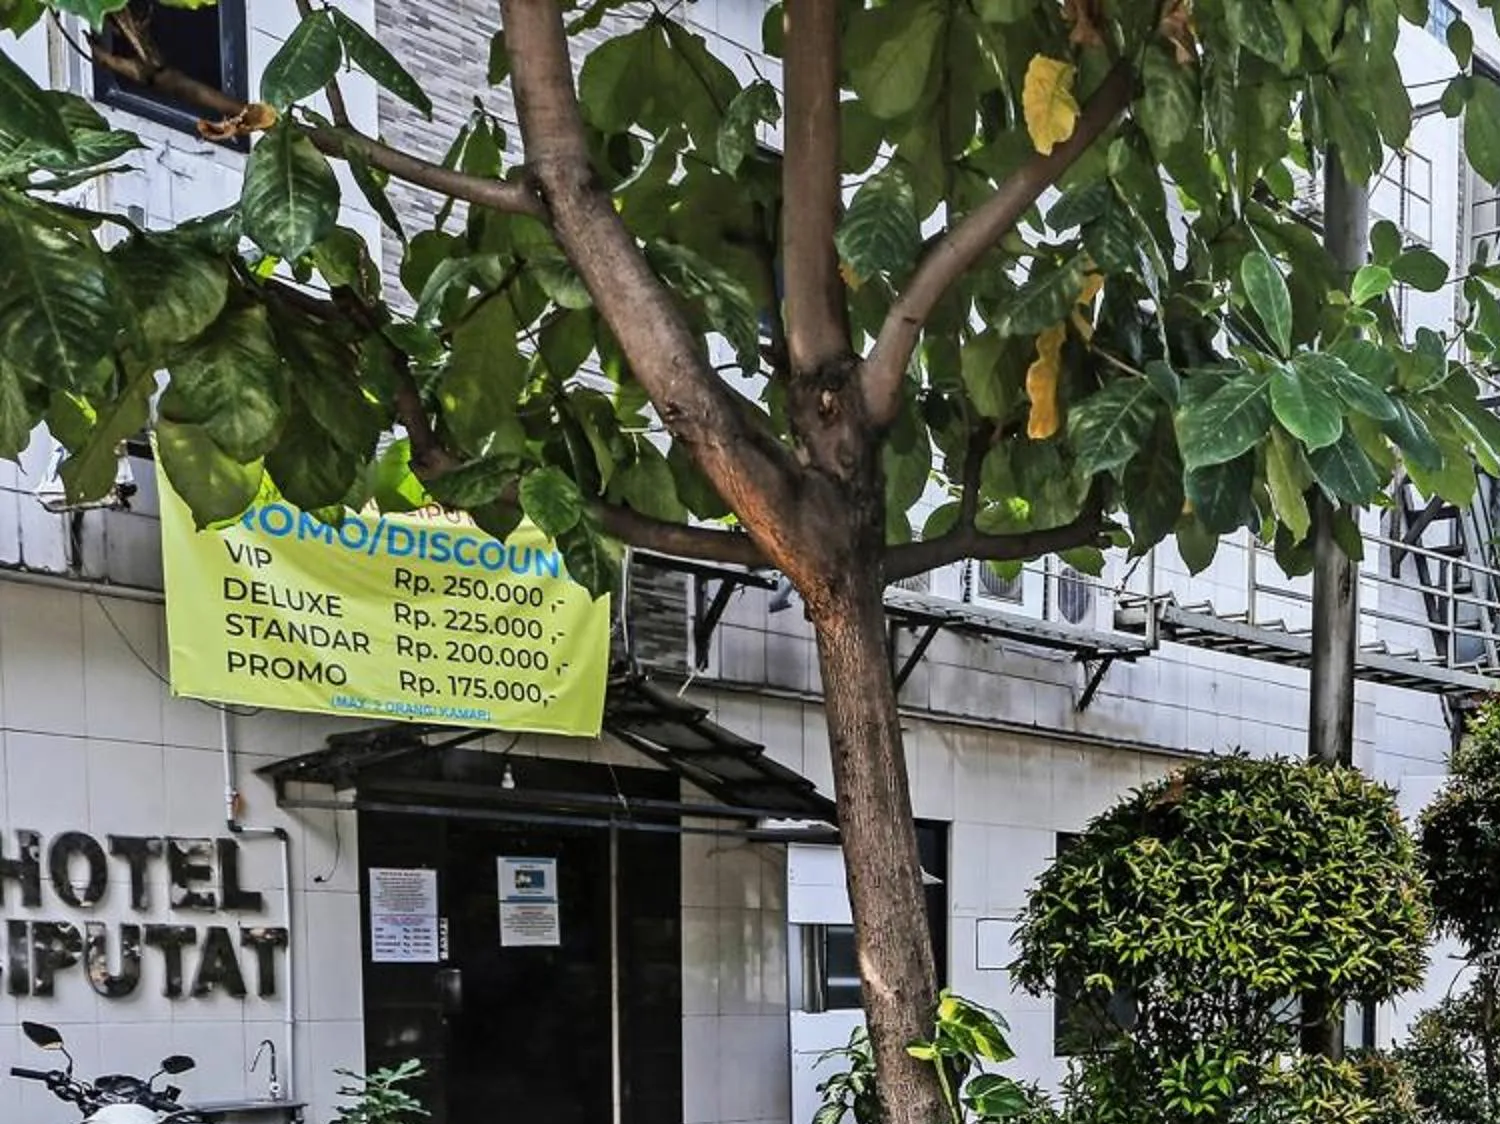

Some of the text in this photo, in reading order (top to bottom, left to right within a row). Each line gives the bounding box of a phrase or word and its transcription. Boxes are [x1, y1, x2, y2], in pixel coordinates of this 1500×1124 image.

[224, 539, 272, 568] VIP
[394, 568, 435, 596] Rp.
[443, 575, 543, 607] 250.000
[223, 577, 342, 618] DELUXE
[394, 602, 436, 630] Rp.
[443, 609, 542, 640] 225.000
[225, 613, 371, 654] STANDAR
[397, 635, 438, 663] Rp.
[445, 641, 549, 671] 200.000
[227, 651, 347, 686] PROMO
[400, 670, 441, 698] Rp.
[0, 829, 262, 912] HOTEL
[0, 919, 288, 998] IPUTAT
